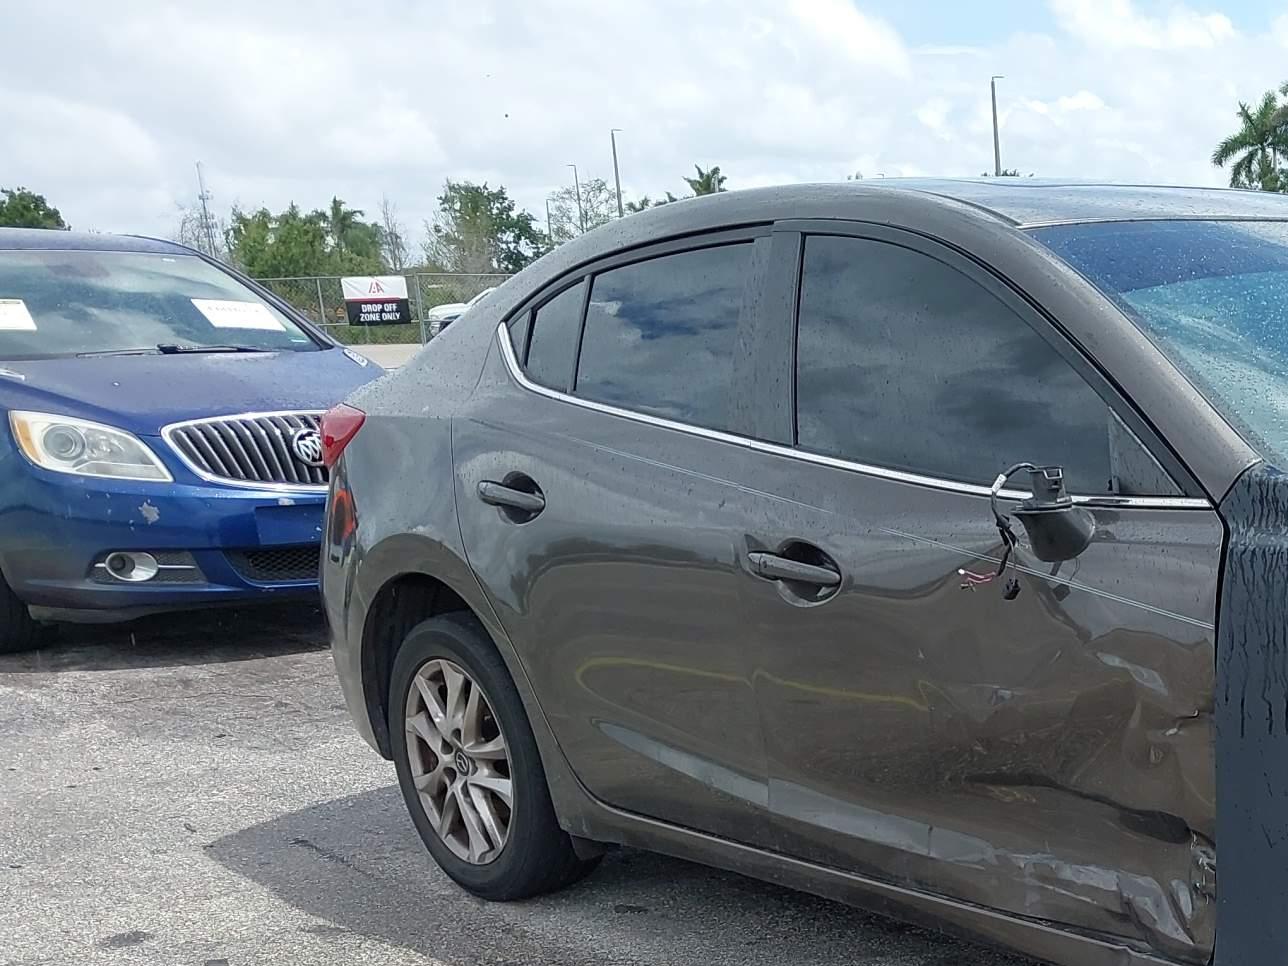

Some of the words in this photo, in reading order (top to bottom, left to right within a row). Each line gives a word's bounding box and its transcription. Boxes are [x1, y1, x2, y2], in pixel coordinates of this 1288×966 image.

[361, 303, 382, 313] DROP
[383, 303, 398, 312] OFF
[359, 313, 381, 322] ZONE
[381, 312, 401, 321] ONLY
